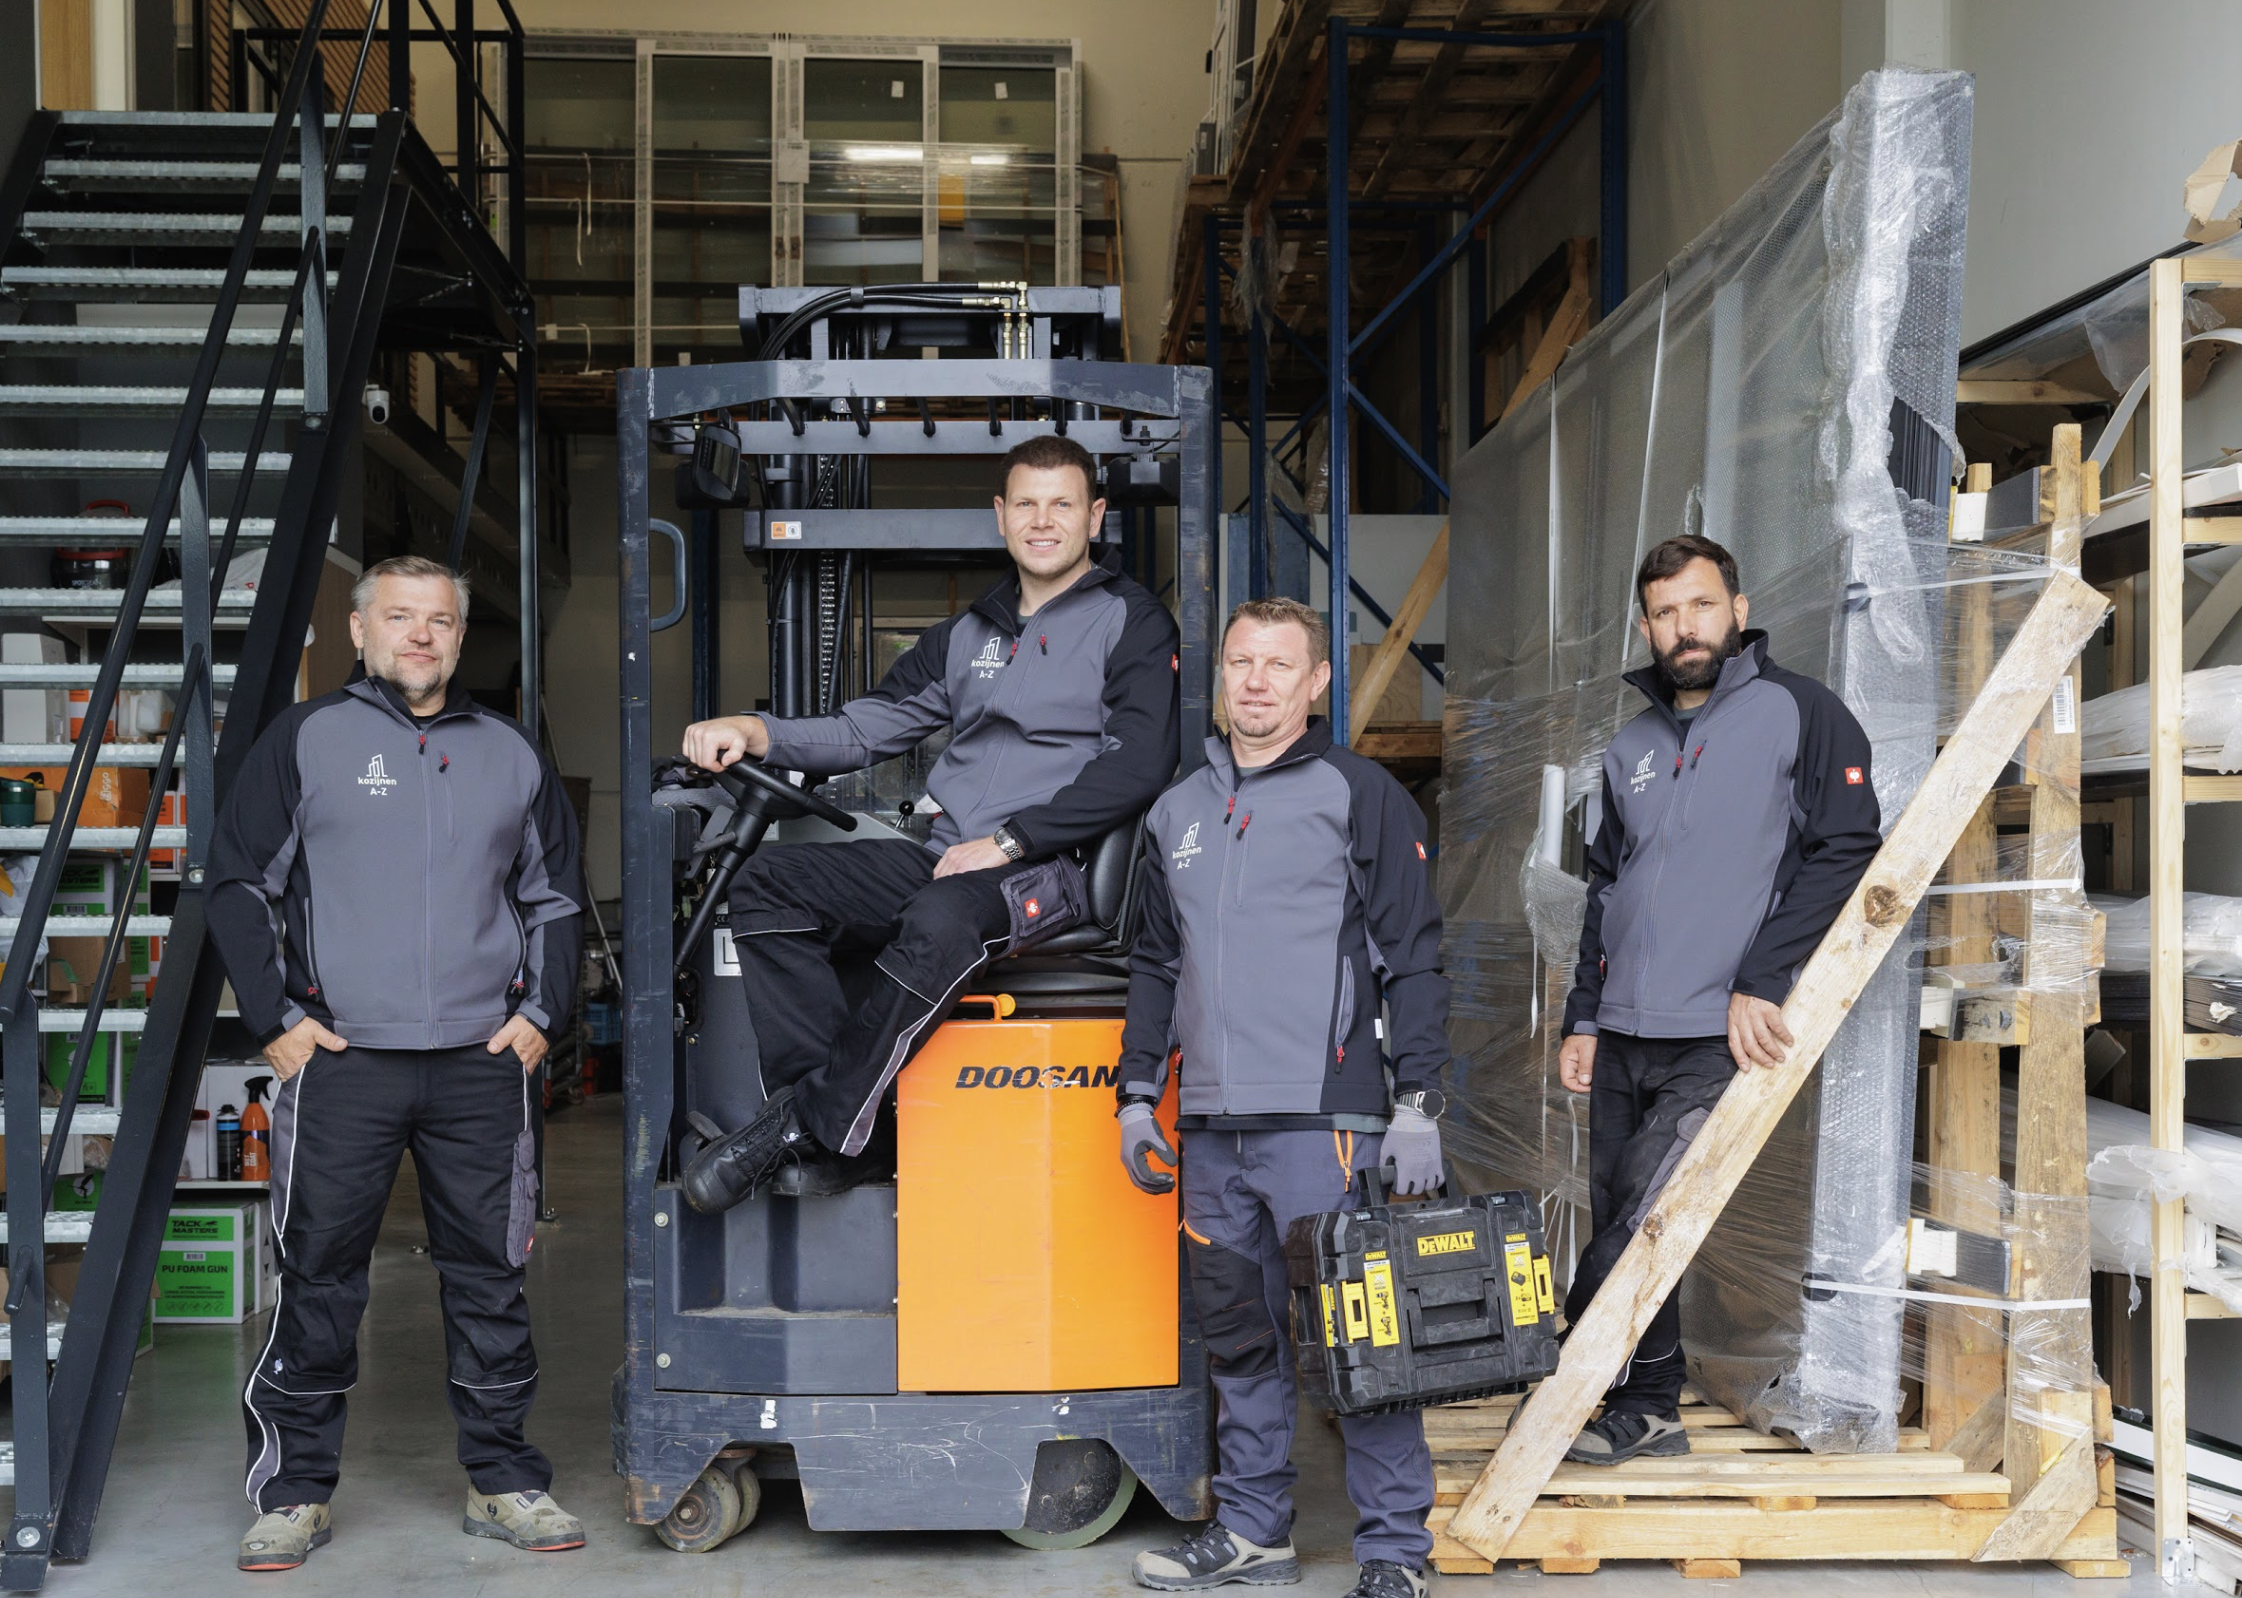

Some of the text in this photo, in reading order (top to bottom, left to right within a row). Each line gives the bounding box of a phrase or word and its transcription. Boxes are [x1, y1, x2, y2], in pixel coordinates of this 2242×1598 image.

[971, 659, 1005, 669] kozijnen
[979, 670, 995, 679] A-Z
[358, 777, 397, 786] kozijnen
[370, 787, 388, 796] A-Z
[1633, 783, 1646, 794] A-Z
[1177, 858, 1191, 870] A-Z
[955, 1065, 1121, 1089] DOOSAN
[172, 1220, 202, 1228] TACK
[162, 1265, 228, 1273] PU FOAM GUN
